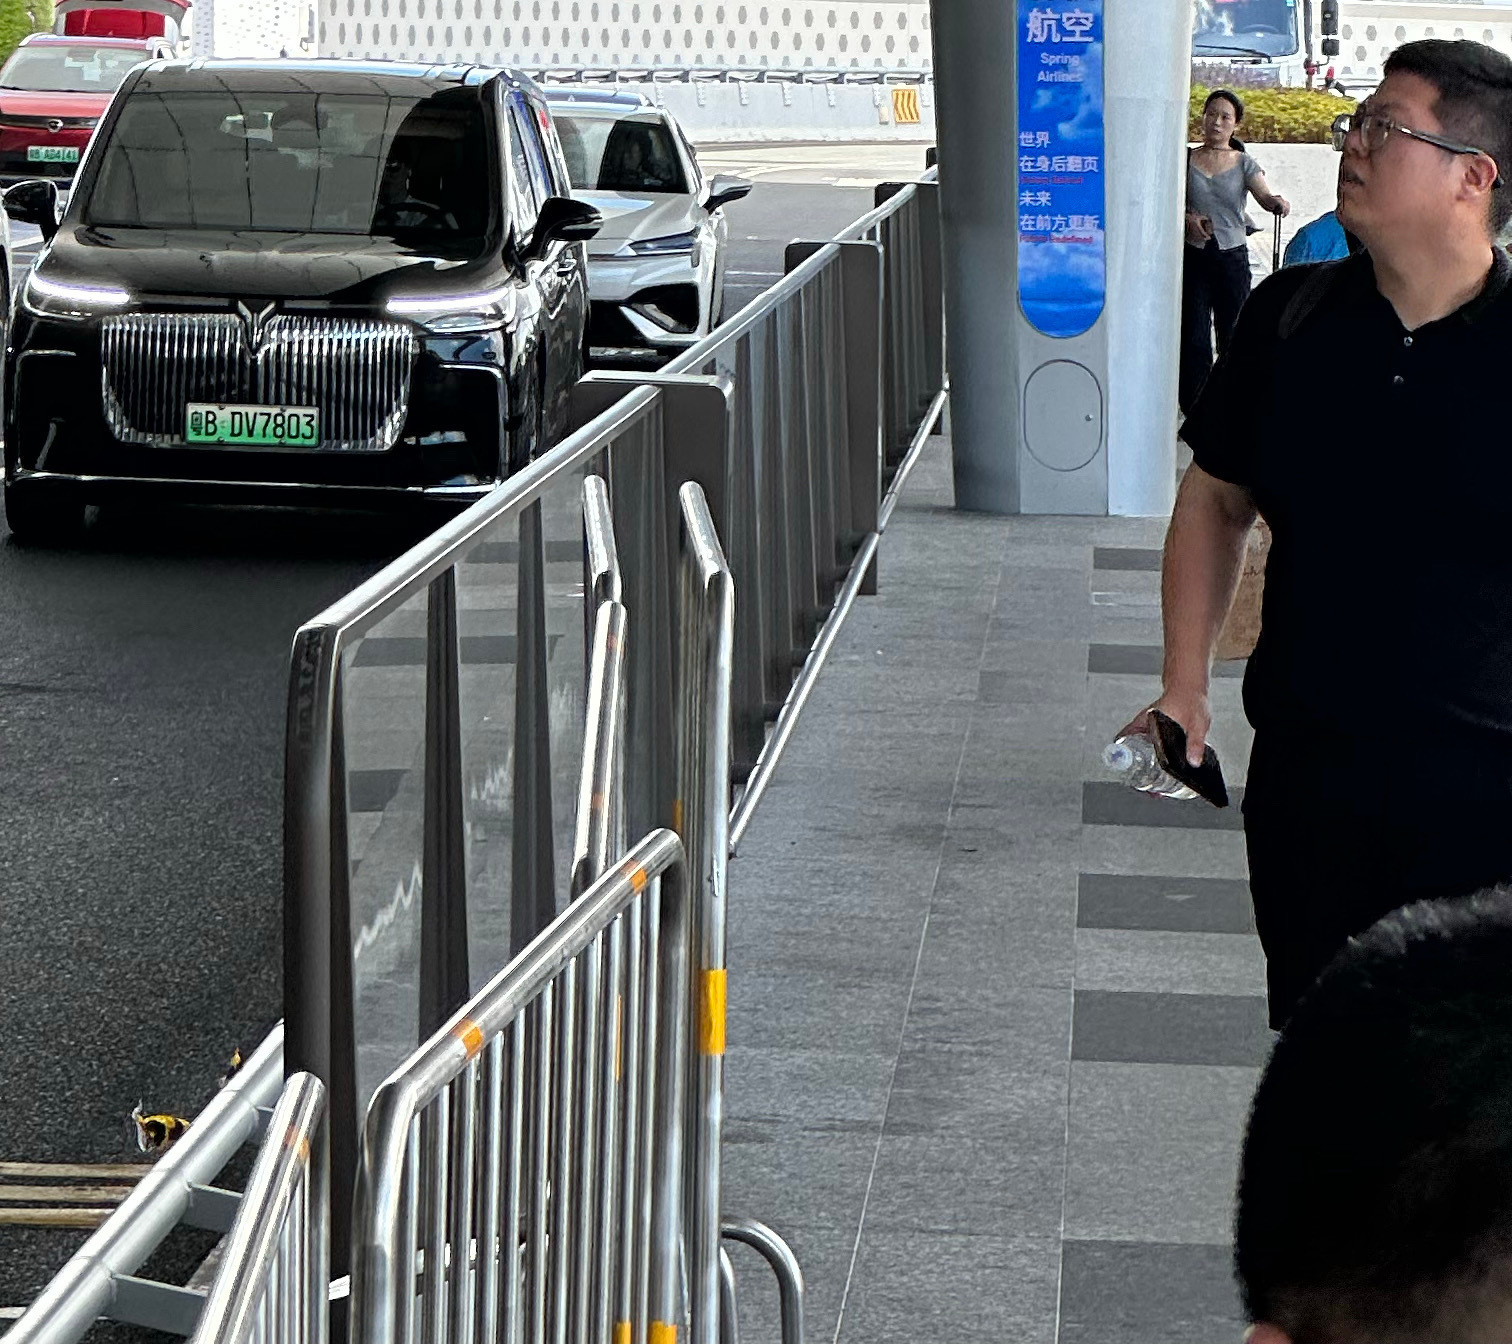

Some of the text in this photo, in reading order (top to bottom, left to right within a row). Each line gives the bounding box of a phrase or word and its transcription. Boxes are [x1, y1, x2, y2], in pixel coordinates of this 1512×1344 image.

[1026, 8, 1094, 43] 航空
[1040, 52, 1081, 66] Spring
[1037, 71, 1084, 82] Airlines
[1019, 131, 1052, 148] 世界
[1019, 155, 1099, 172] 在身后翻页
[1019, 190, 1052, 207] 未来
